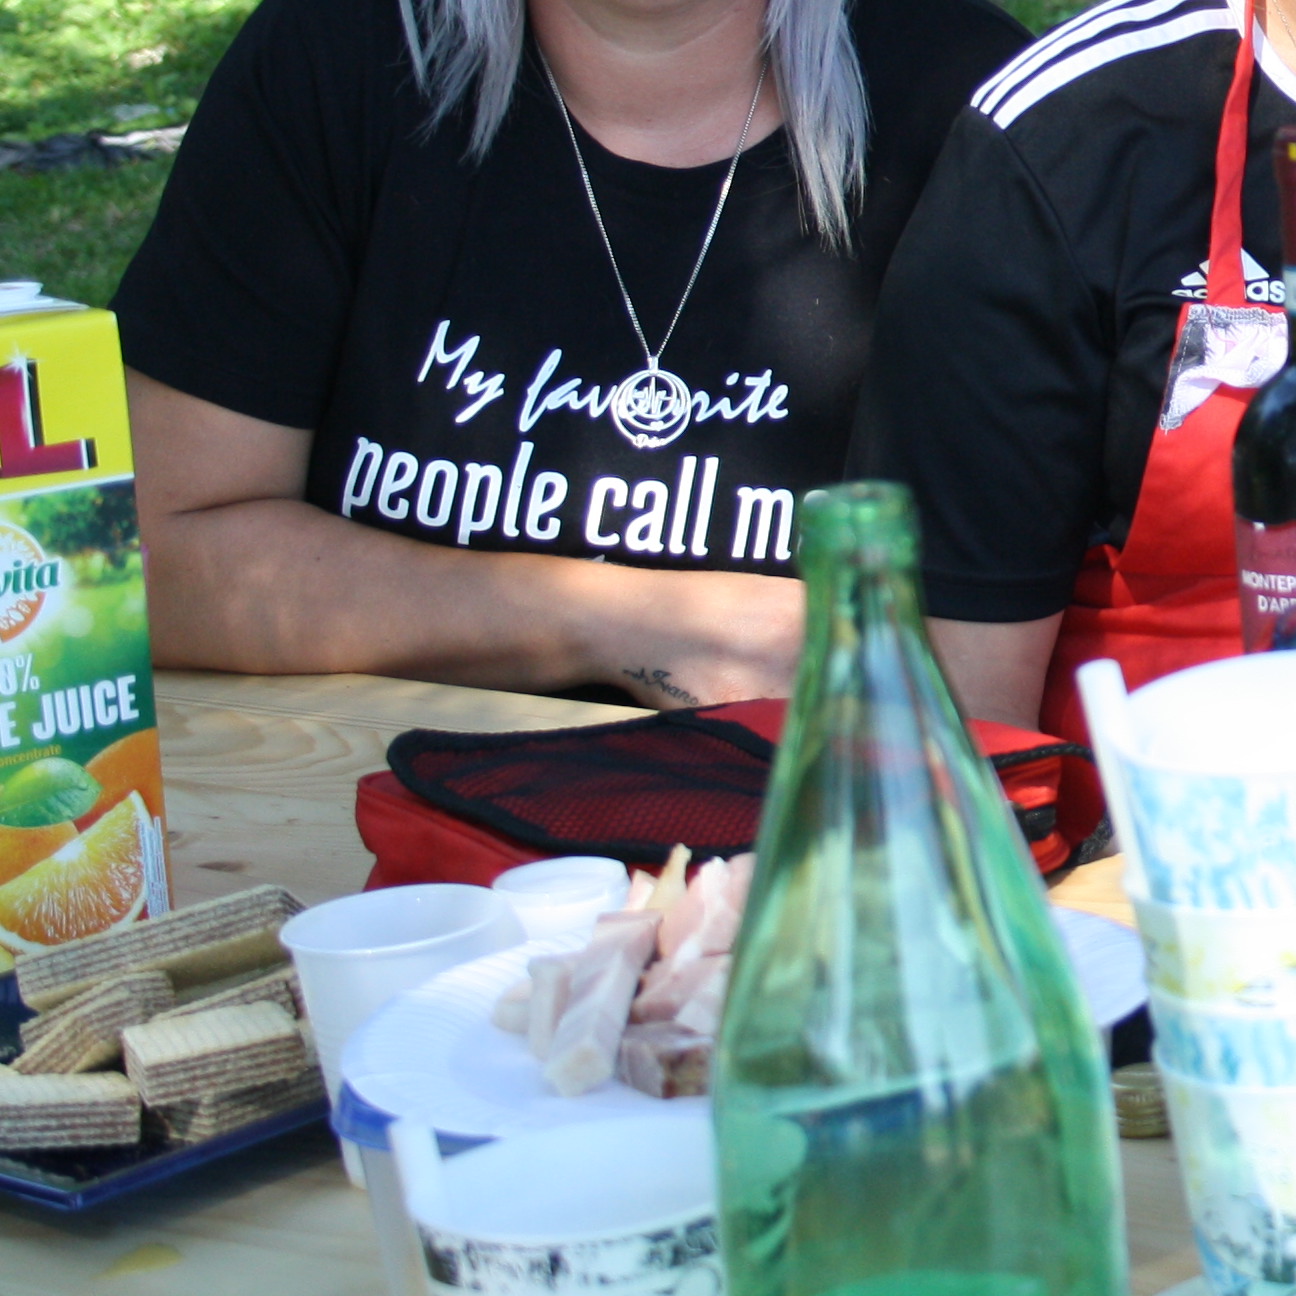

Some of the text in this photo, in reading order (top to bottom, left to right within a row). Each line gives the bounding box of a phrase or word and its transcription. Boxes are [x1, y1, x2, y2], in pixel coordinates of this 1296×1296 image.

[417, 319, 790, 433] My favrite
[341, 436, 801, 560] people call m
[32, 674, 140, 741] JUICE
